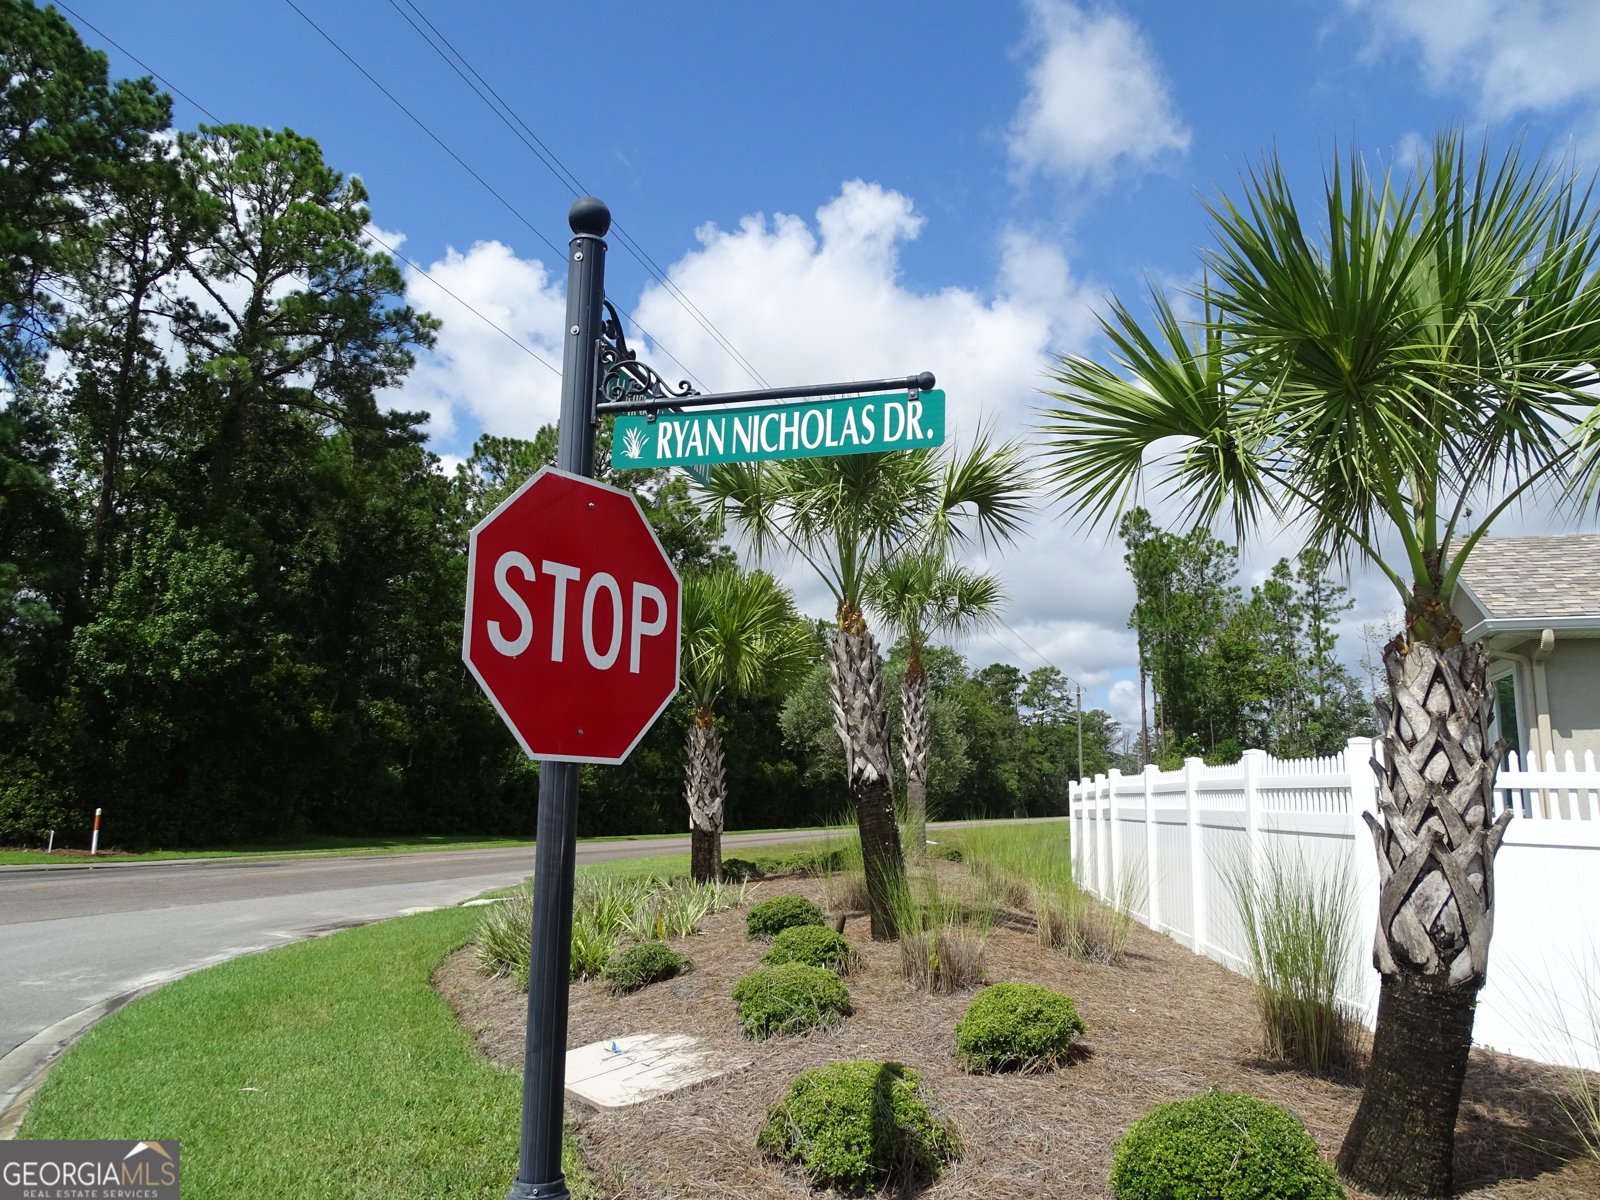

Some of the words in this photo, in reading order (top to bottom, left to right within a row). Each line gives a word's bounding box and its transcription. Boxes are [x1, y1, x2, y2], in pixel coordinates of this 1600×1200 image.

[656, 417, 725, 460] RYAN
[732, 403, 875, 454] NICHOLAS
[883, 401, 934, 443] DR.
[486, 550, 668, 674] STOP
